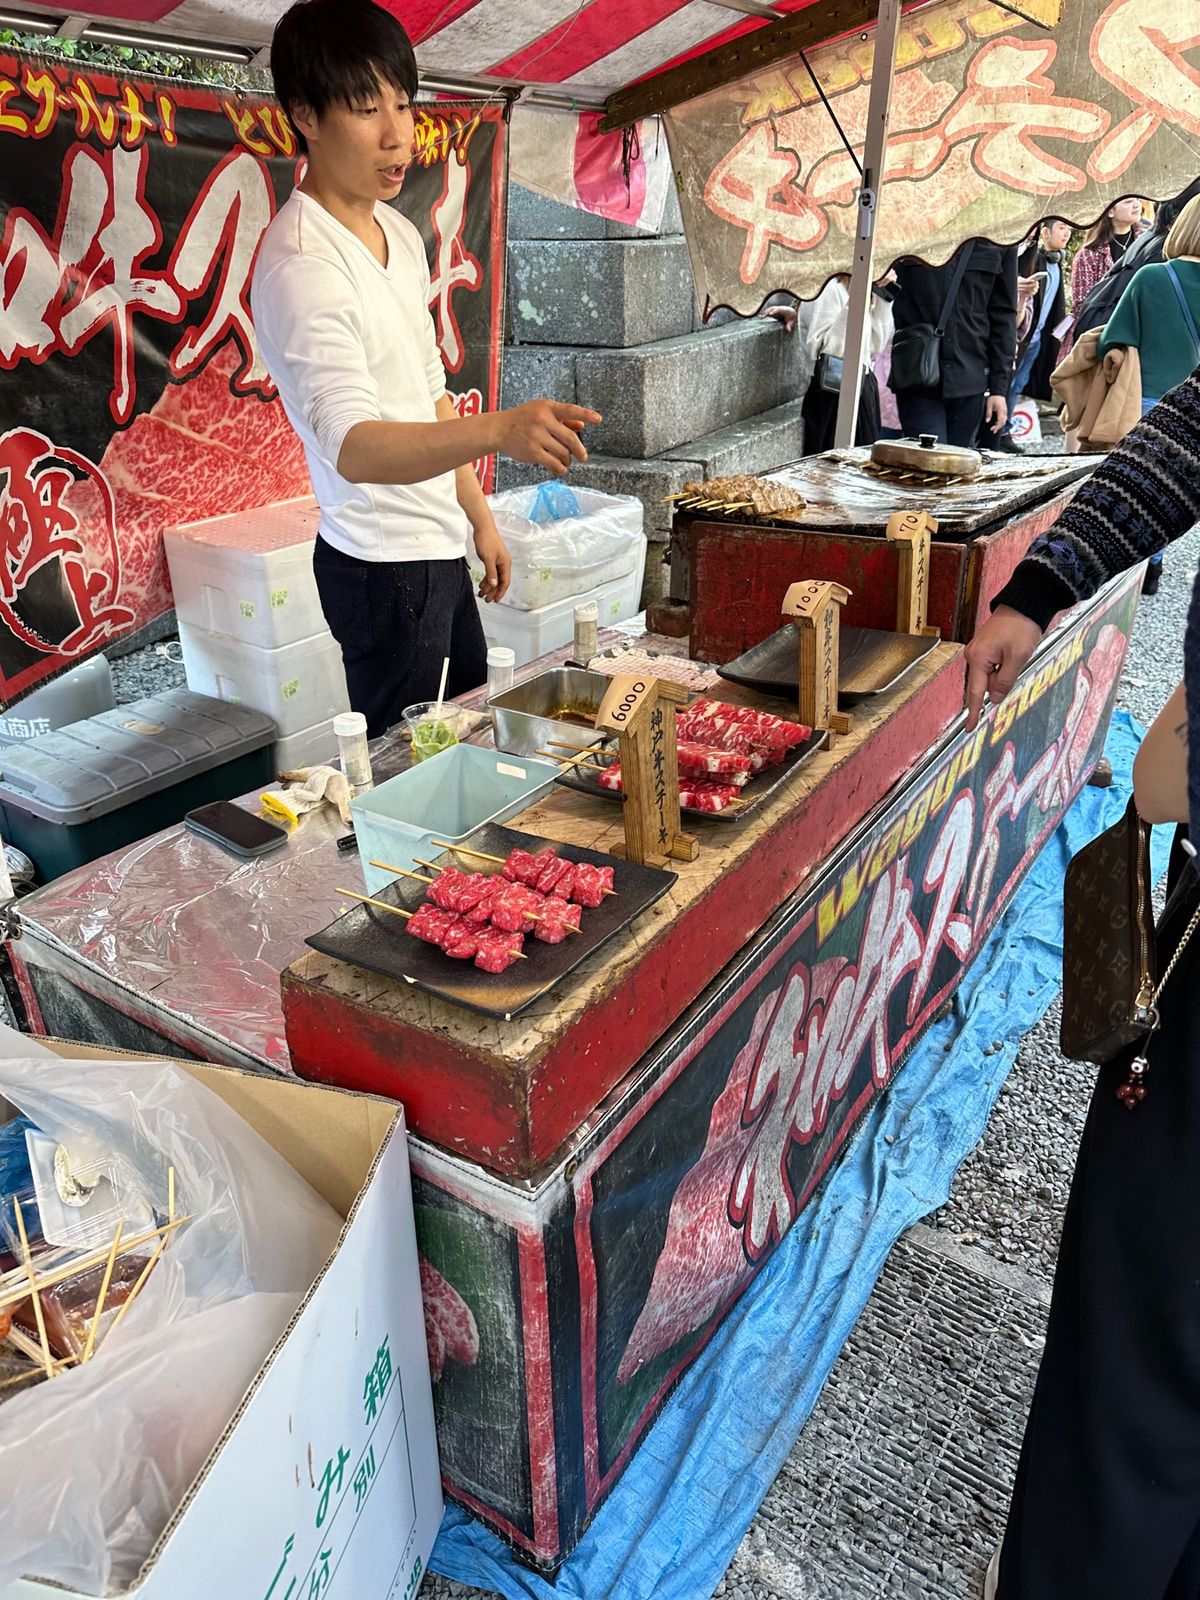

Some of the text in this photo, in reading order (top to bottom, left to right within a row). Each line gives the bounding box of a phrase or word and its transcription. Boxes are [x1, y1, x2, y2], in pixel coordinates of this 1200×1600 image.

[899, 511, 922, 532] 70
[611, 681, 646, 722] 6000
[650, 708, 669, 844] 神戸牛ステーキ
